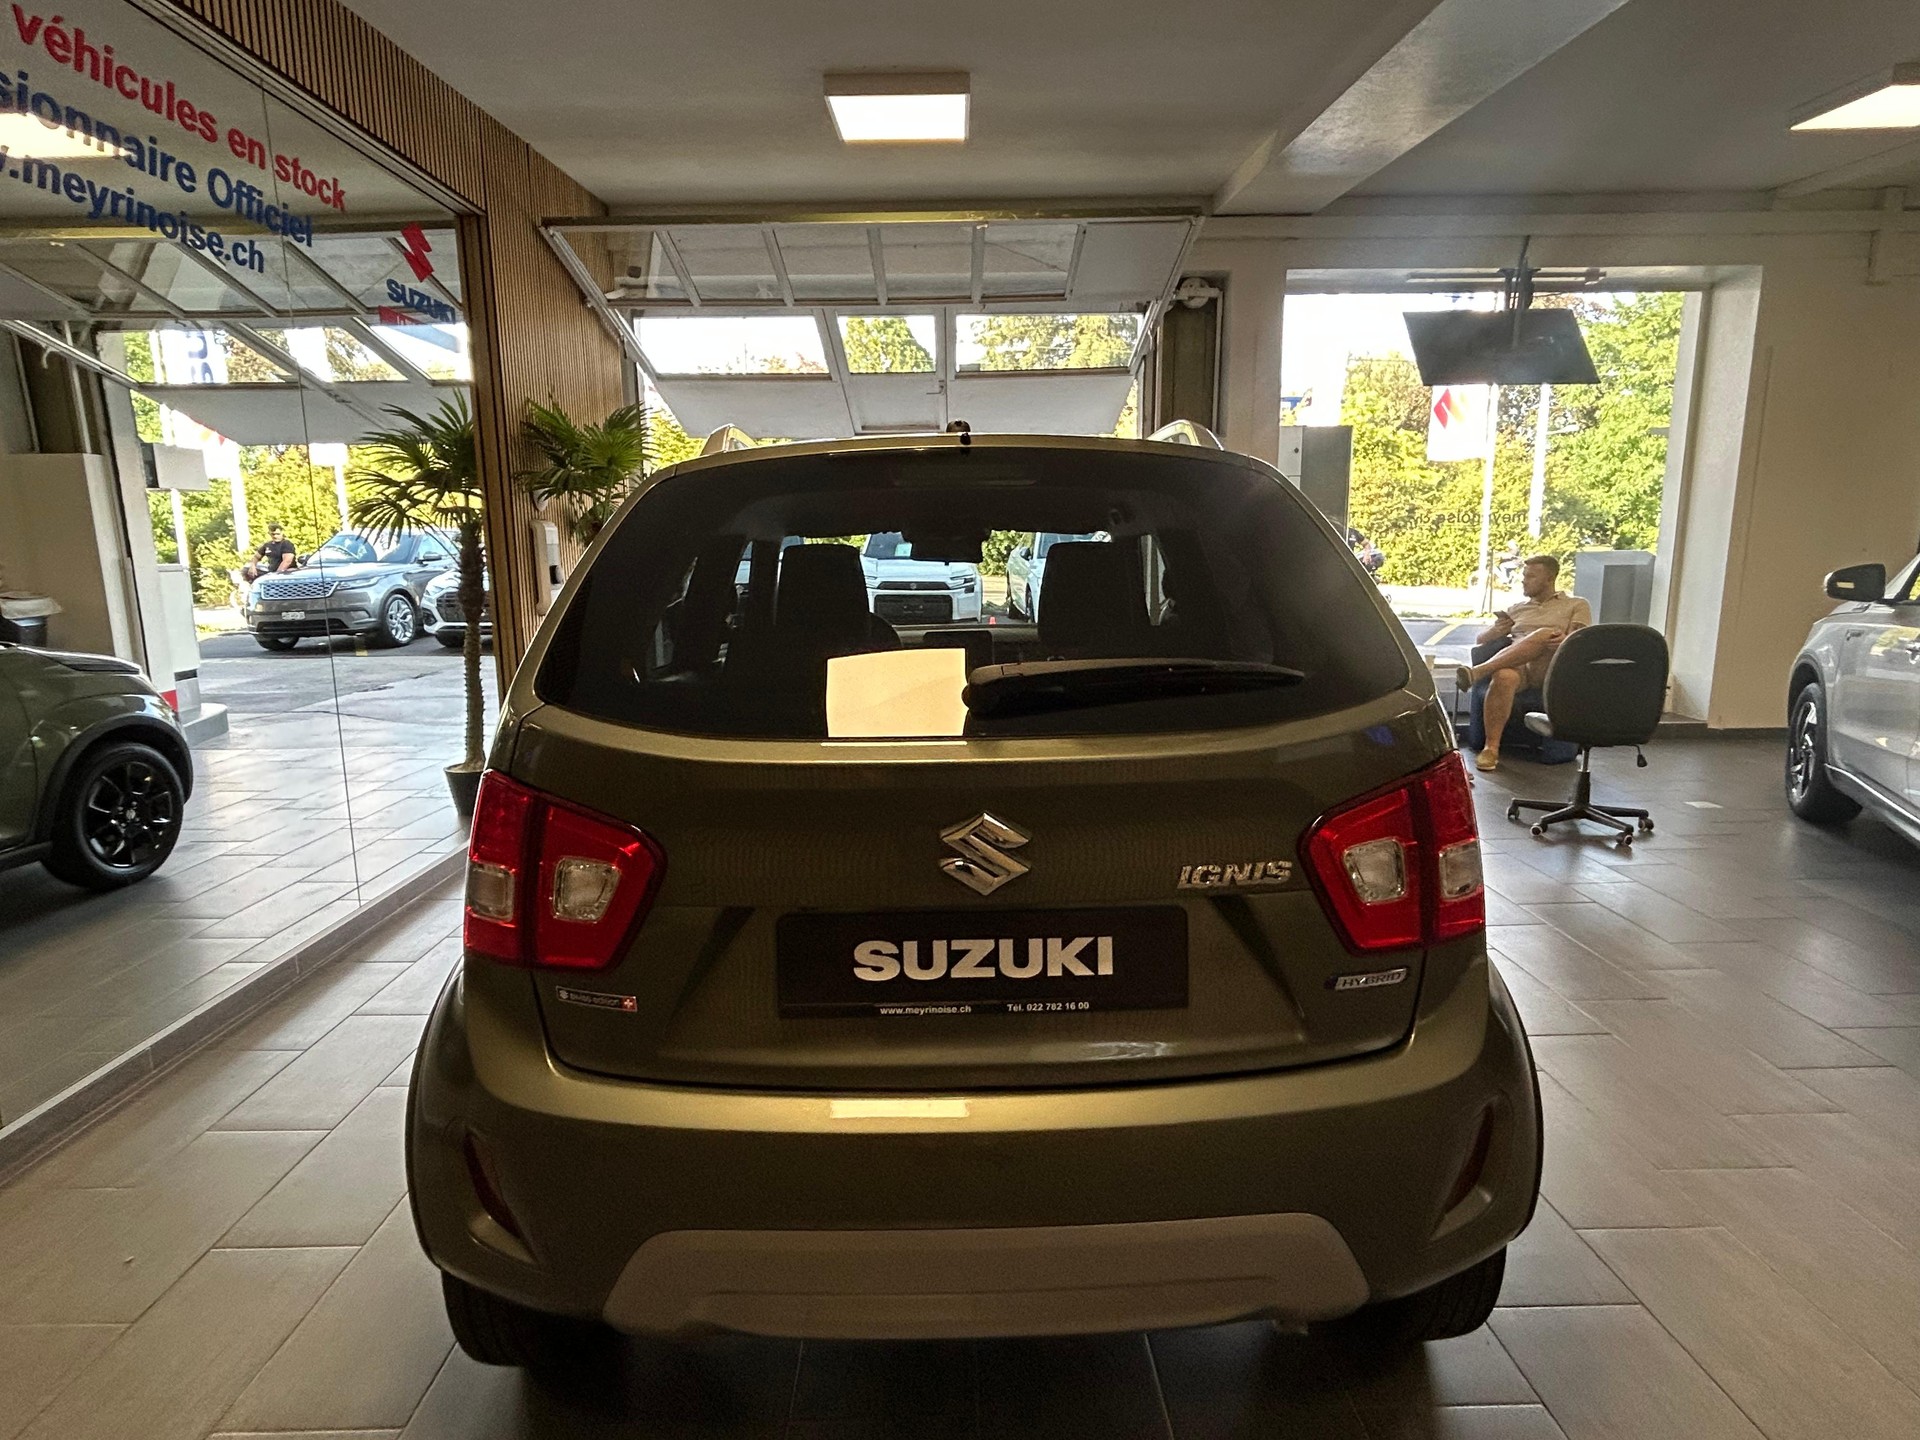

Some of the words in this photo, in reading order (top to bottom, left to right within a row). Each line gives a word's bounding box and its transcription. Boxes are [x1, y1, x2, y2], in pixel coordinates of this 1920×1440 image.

[12, 3, 218, 143] véhicules
[227, 128, 267, 170] en
[274, 153, 347, 213] stock
[207, 168, 312, 247] Officiel
[386, 278, 456, 325] SUZUKI
[1177, 860, 1292, 889] IGNIS
[853, 936, 1114, 982] SUZUKI
[880, 1005, 972, 1016] www.meyrinoise.ch
[1026, 1003, 1044, 1012] 022
[1046, 1002, 1063, 1011] 782
[1065, 1002, 1076, 1010] 16
[1078, 1001, 1090, 1010] 00
